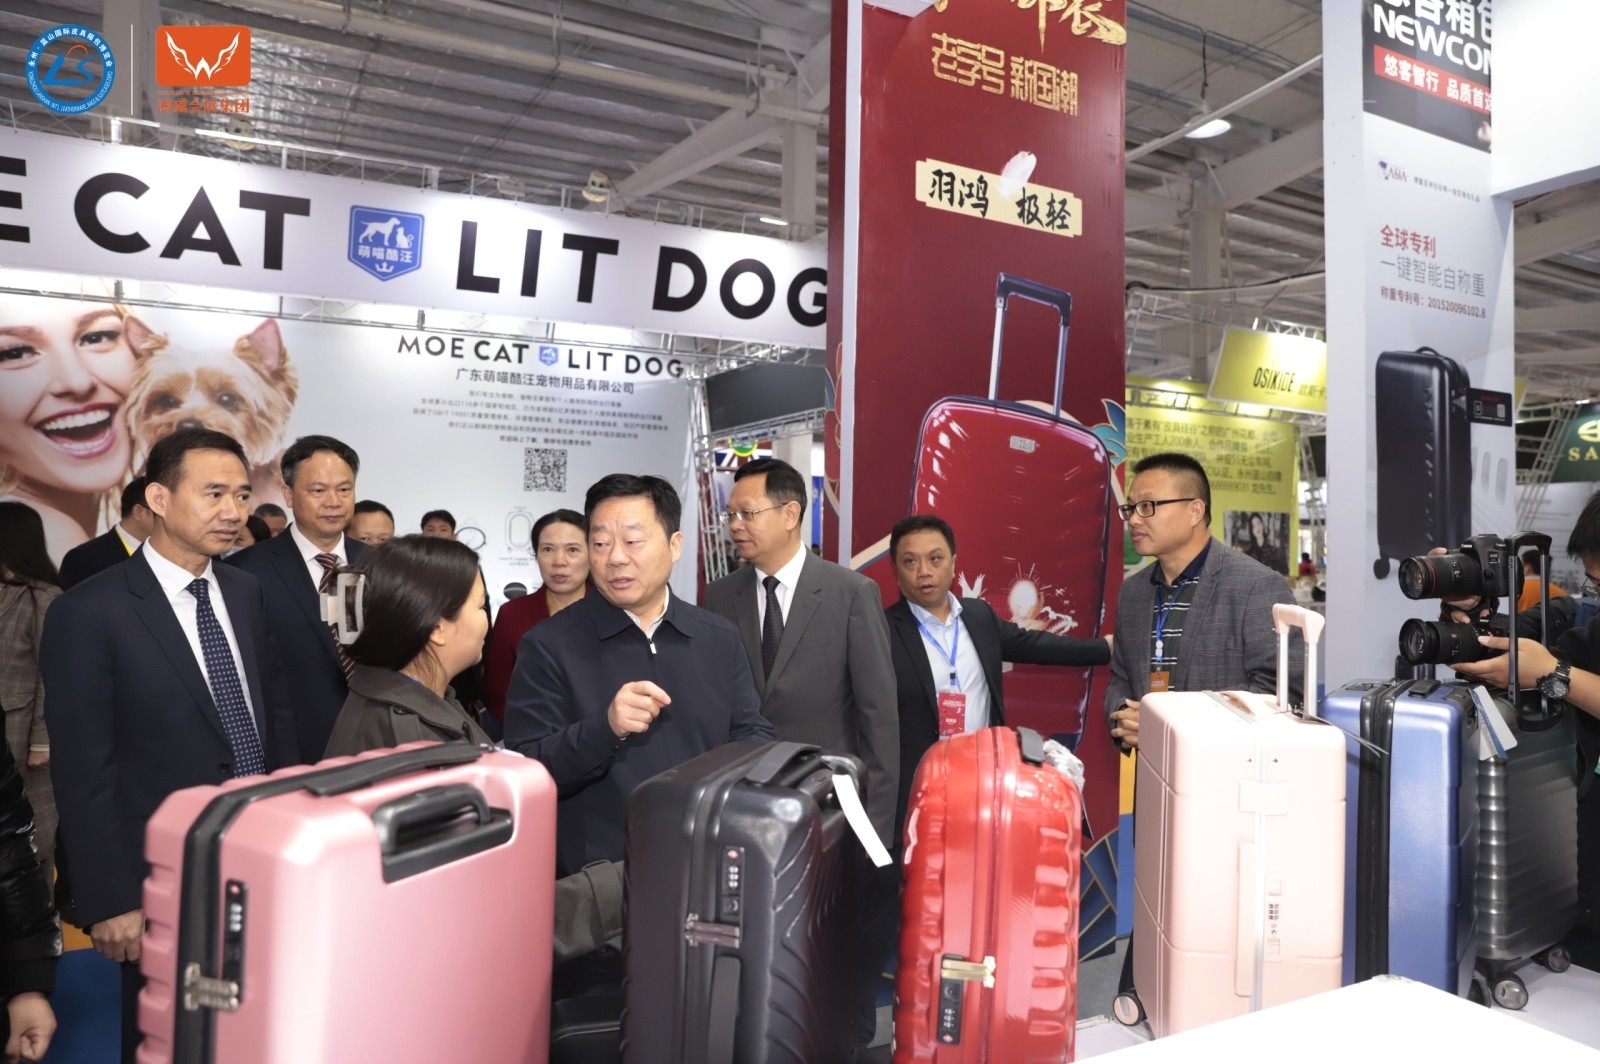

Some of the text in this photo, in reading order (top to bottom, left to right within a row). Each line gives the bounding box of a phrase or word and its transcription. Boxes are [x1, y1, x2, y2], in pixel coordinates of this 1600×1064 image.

[929, 168, 1072, 231] 羽鸿 极轻
[74, 172, 311, 270] CAT
[456, 220, 620, 304] LIT
[652, 245, 827, 327] DOG
[358, 245, 413, 263] 萌喵酷汪
[1380, 224, 1436, 258] 全球专利
[1380, 255, 1486, 297] 一键智能自称重
[398, 335, 684, 378] MOE CAT LIT DOG
[455, 367, 635, 395] 广东萌喵酷汪宠物用品有限公司
